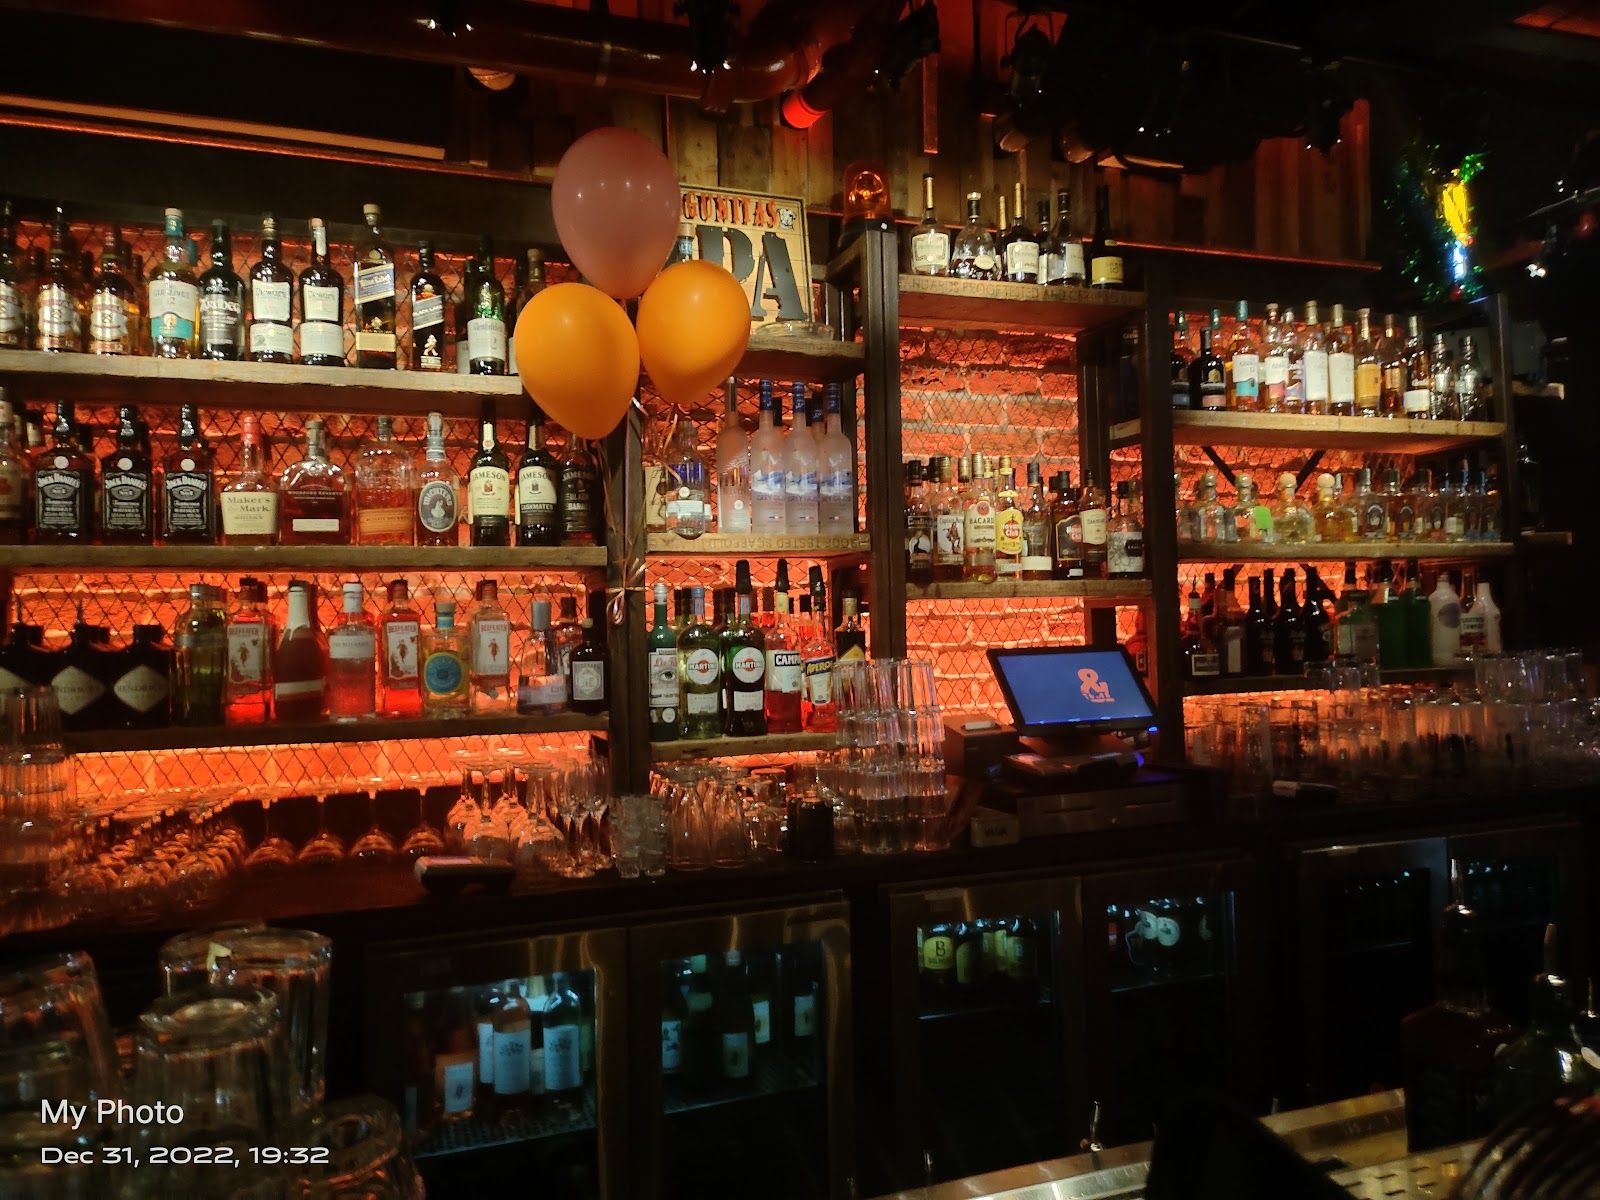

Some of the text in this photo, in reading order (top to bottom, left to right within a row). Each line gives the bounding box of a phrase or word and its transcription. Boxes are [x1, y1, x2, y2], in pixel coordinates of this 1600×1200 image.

[668, 225, 807, 321] PA
[227, 496, 271, 504] Maker's
[969, 517, 995, 525] BACARD
